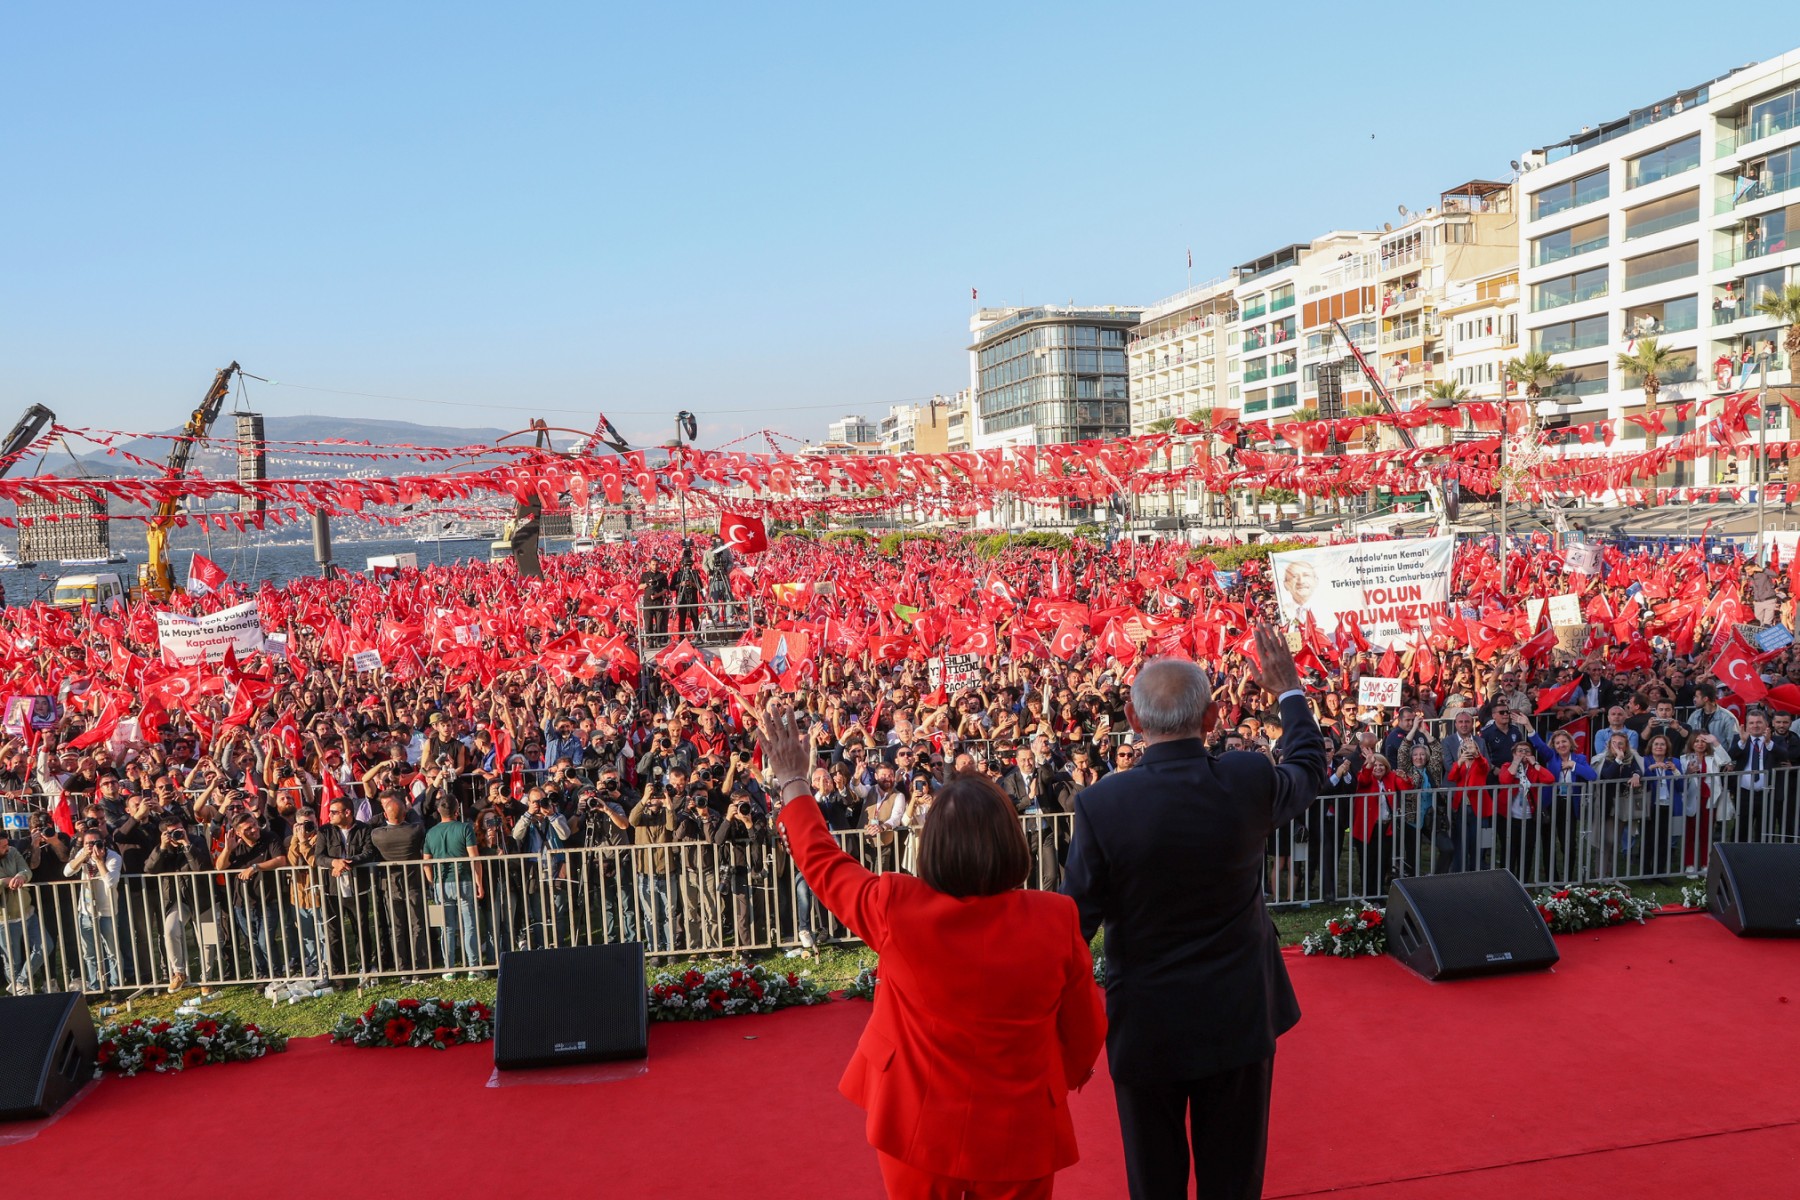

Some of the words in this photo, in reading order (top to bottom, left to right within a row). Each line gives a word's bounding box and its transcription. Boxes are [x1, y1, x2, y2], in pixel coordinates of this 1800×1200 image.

[1348, 553, 1398, 563] Anadolu'nun
[1400, 548, 1430, 559] Kemal'i
[1356, 565, 1395, 575] Hepimizin
[1397, 561, 1424, 570] Umudu
[1331, 578, 1374, 589] Türkiye'nin
[1375, 576, 1387, 584] 13.
[1389, 571, 1448, 583] Cumhurbaşkanı
[1363, 585, 1422, 605] YOLUN
[158, 618, 170, 626] Bu
[205, 617, 222, 625] çok
[160, 630, 171, 638] 14
[172, 627, 214, 638] Mayıs'ta
[186, 634, 240, 648] Kapatalım.
[4, 815, 29, 828] POL
